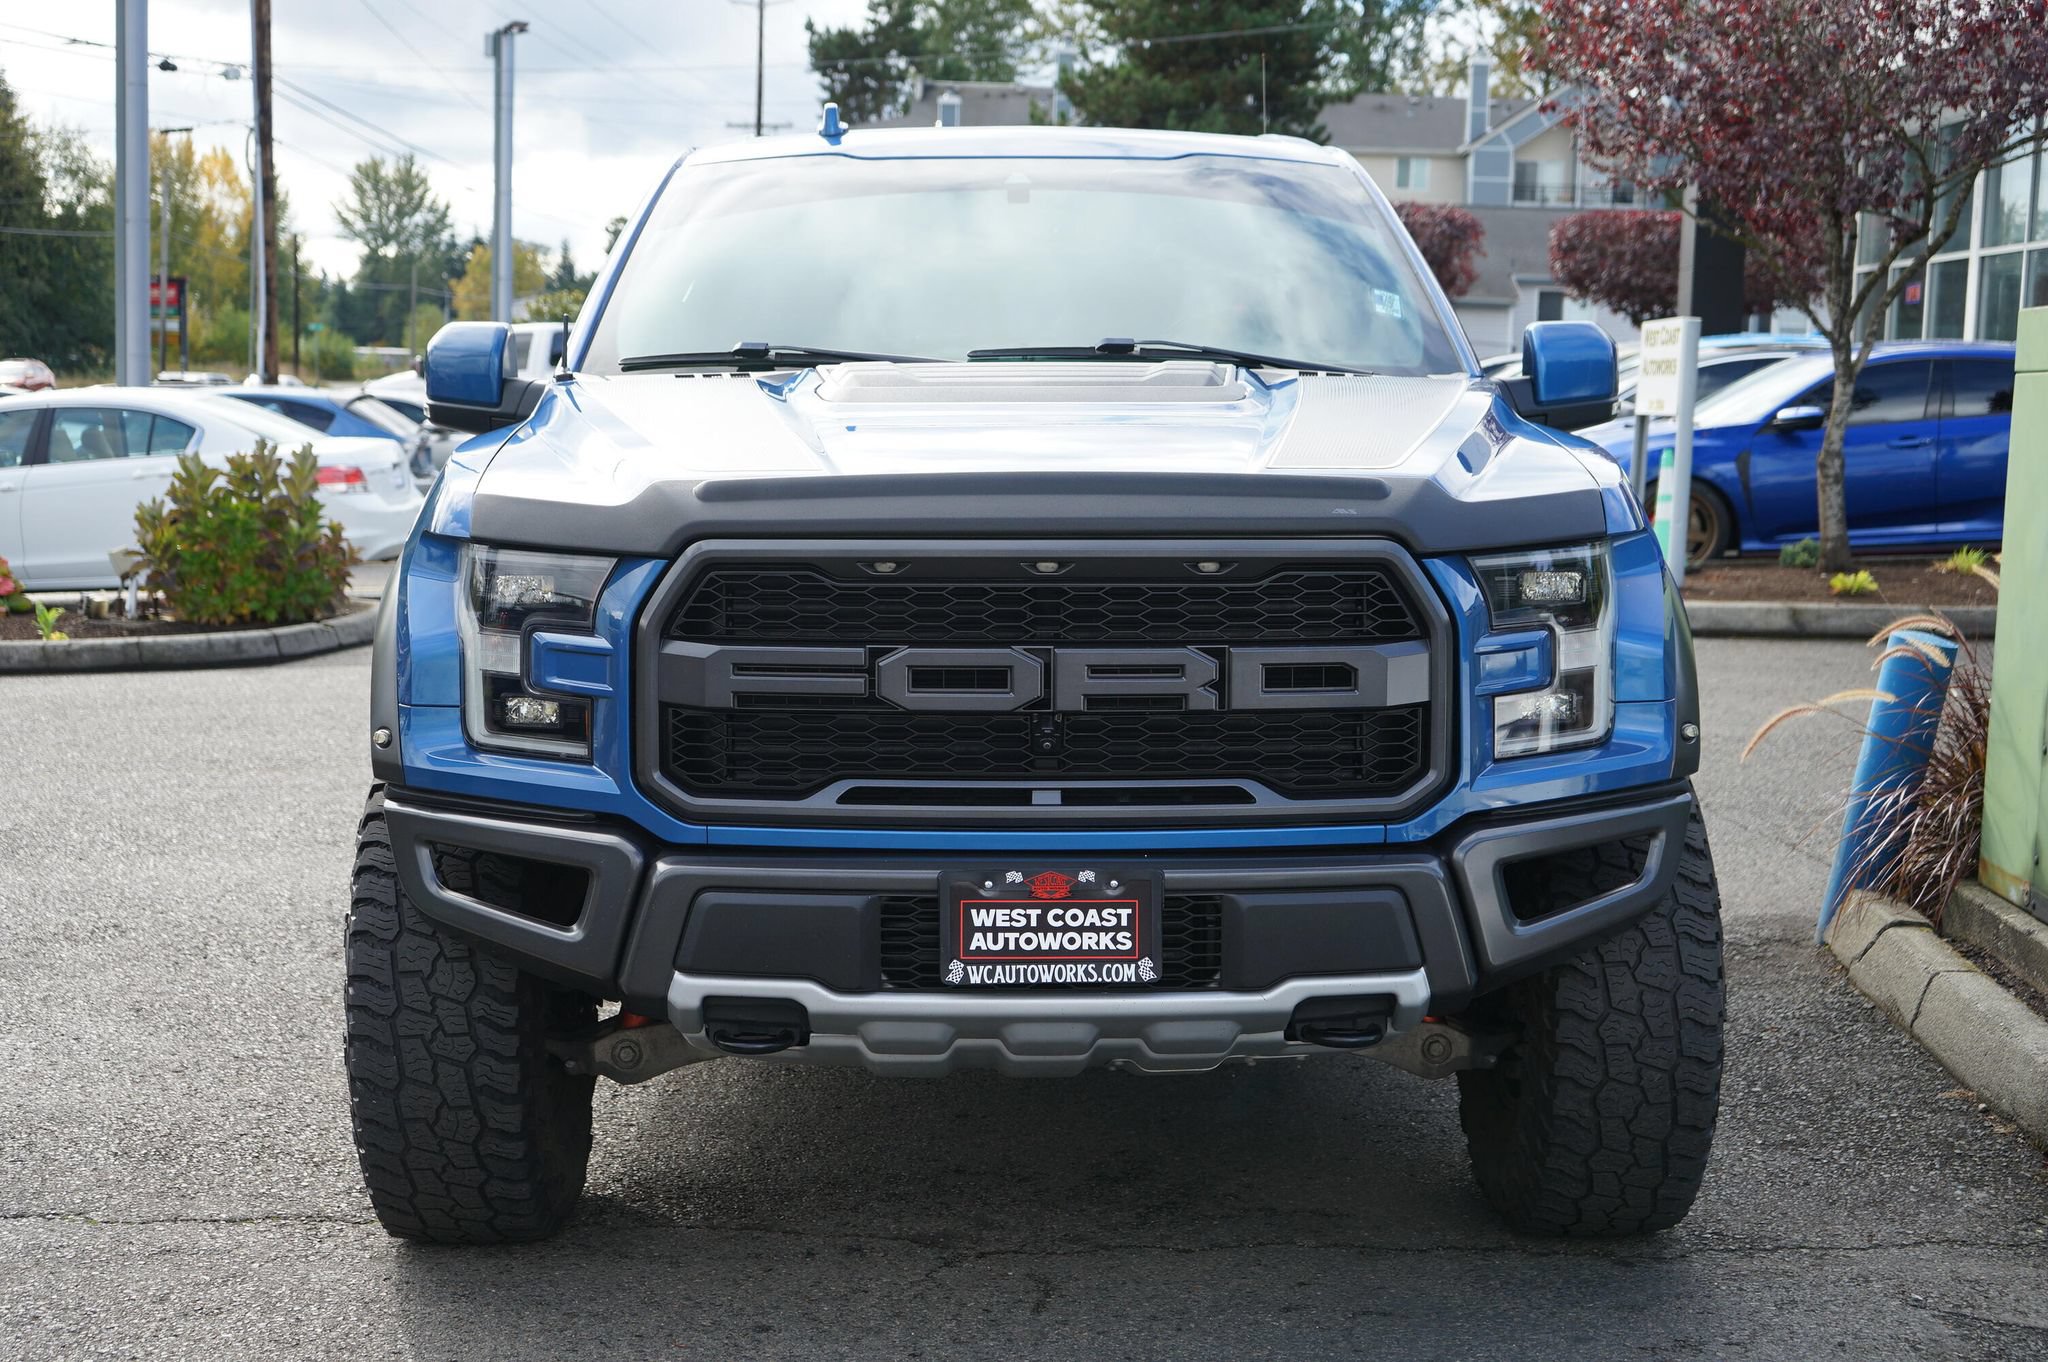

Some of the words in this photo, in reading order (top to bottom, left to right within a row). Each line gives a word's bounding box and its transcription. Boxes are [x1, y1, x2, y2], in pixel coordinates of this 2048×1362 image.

[660, 640, 1432, 712] FORD
[970, 908, 1041, 927] WEST
[1047, 908, 1132, 927] COAST
[969, 931, 1132, 950] AUTOWORKS
[967, 964, 1136, 984] WCAUTOWORKS.COM
